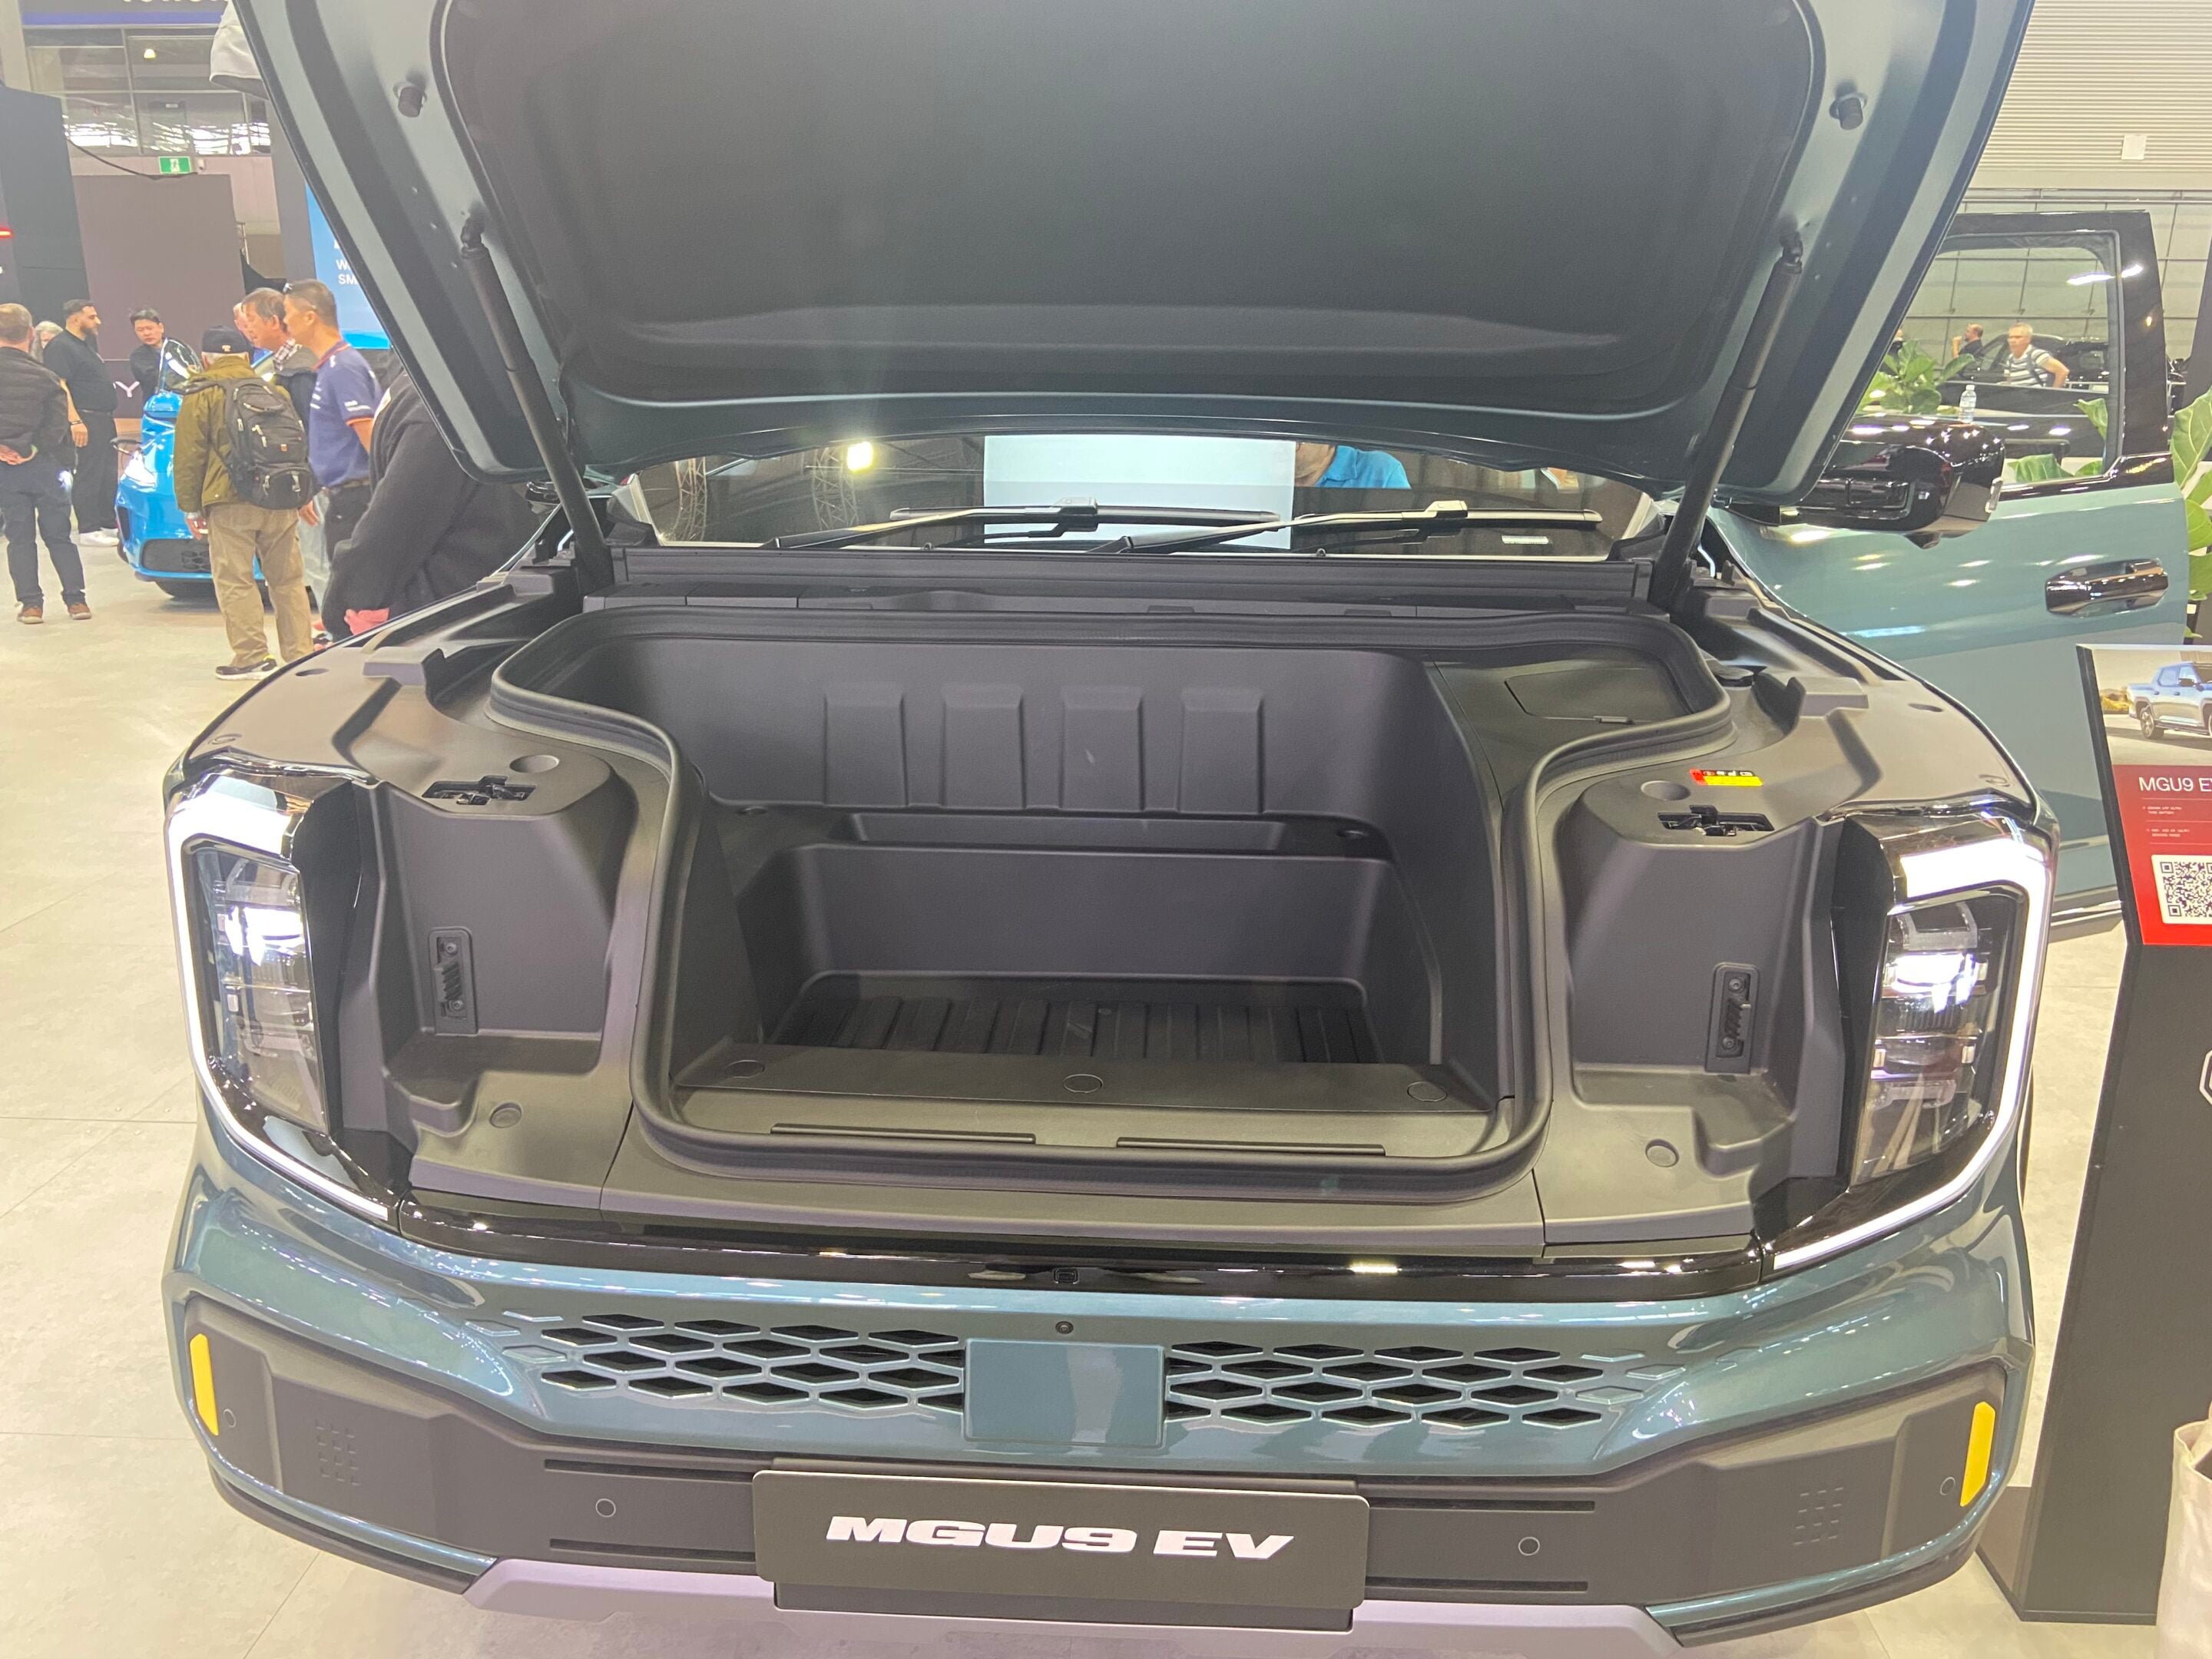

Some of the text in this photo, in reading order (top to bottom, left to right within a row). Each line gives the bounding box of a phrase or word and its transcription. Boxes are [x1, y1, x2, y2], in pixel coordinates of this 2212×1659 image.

[336, 259, 349, 270] W
[338, 273, 358, 285] SM
[2138, 777, 2212, 792] MGU9 E
[826, 1515, 1295, 1559] MGU9 EV
